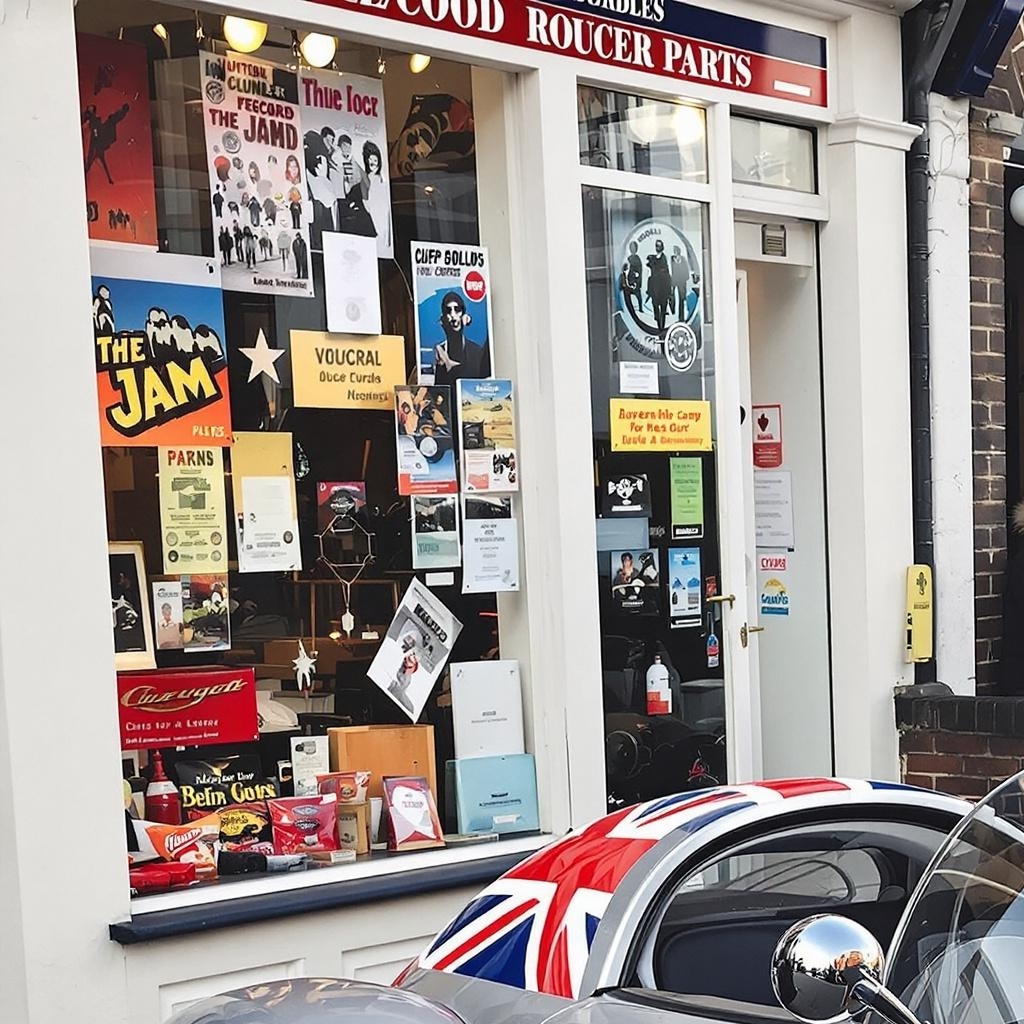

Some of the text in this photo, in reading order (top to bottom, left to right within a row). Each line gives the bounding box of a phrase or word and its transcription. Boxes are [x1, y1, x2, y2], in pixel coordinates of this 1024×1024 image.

[526, 6, 653, 68] ROUCER
[662, 38, 752, 88] PARTS
[208, 108, 239, 130] THE
[97, 336, 146, 364] THE
[315, 347, 381, 366] VOUCRAL
[111, 356, 217, 428] JAM
[168, 450, 214, 467] PARNS
